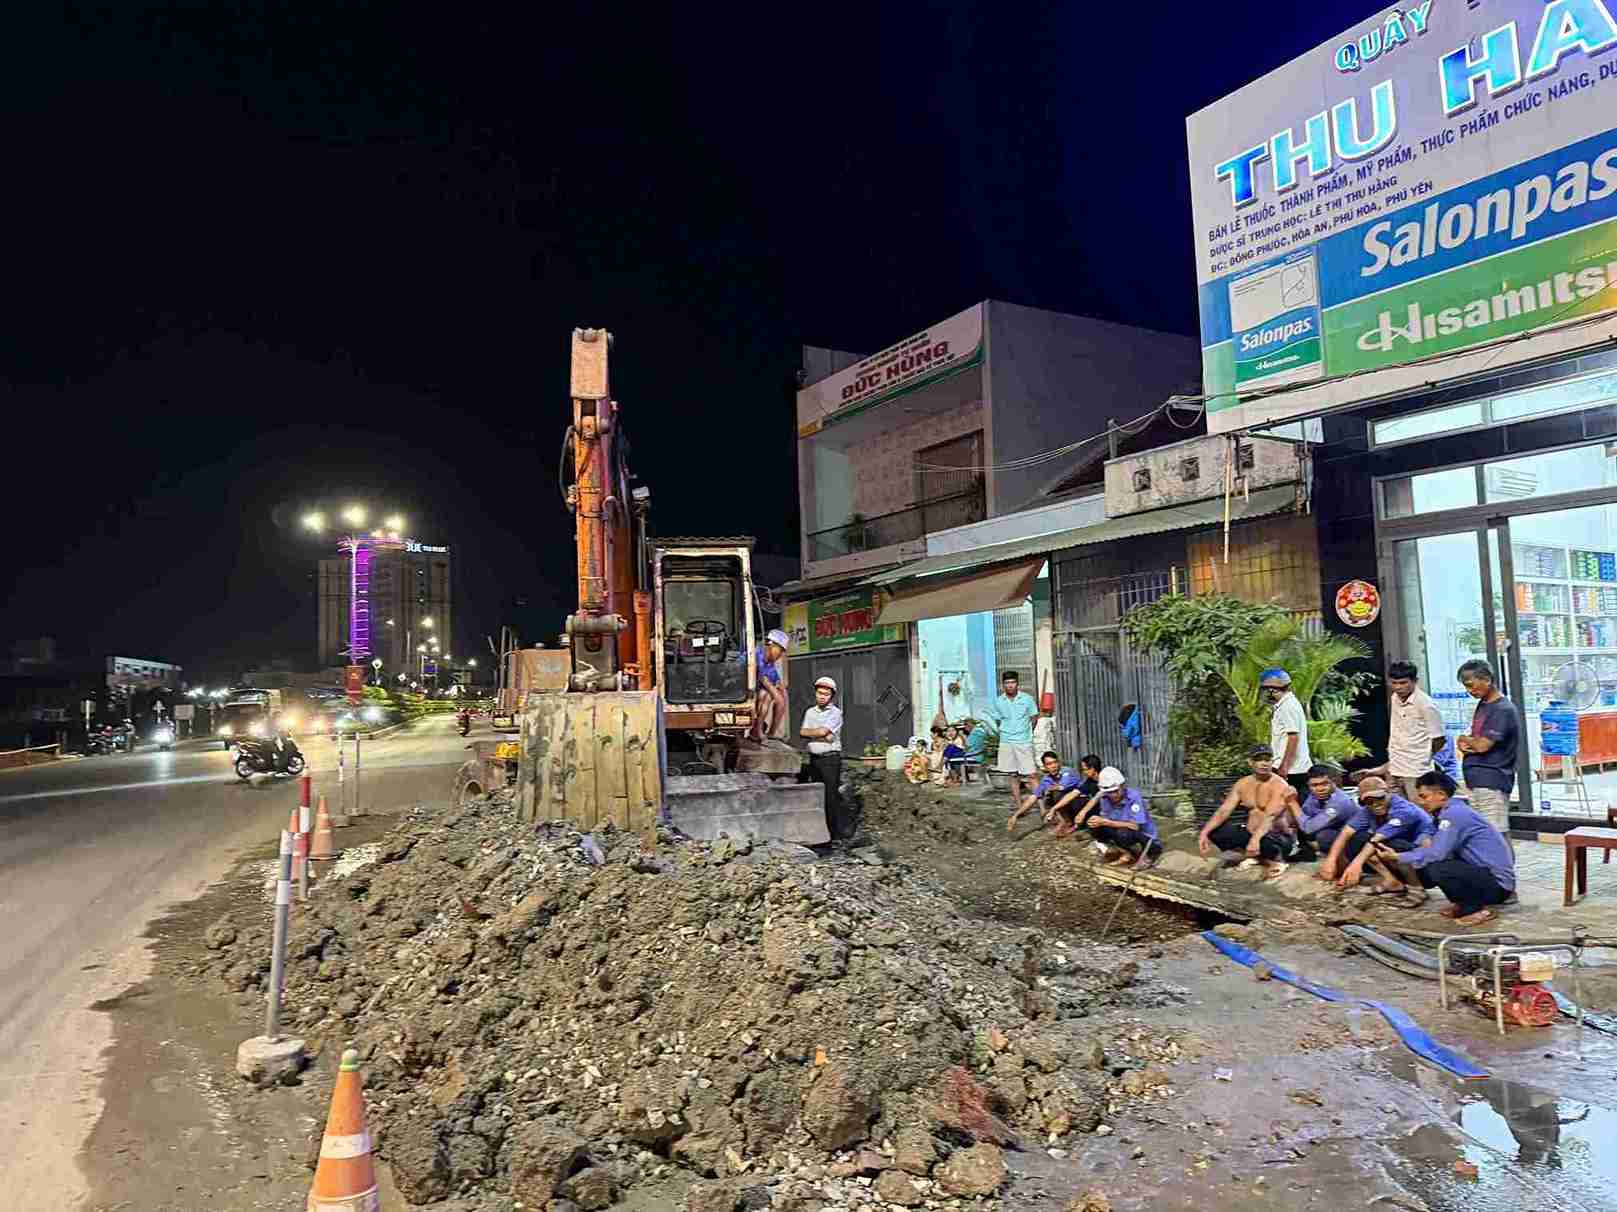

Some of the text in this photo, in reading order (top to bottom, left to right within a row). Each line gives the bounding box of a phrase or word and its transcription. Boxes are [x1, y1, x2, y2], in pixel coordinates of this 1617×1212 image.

[1215, 78, 1399, 210] THU
[1345, 188, 1367, 204] THU
[1360, 147, 1617, 278] Salonpas
[1239, 316, 1313, 352] Salonpas
